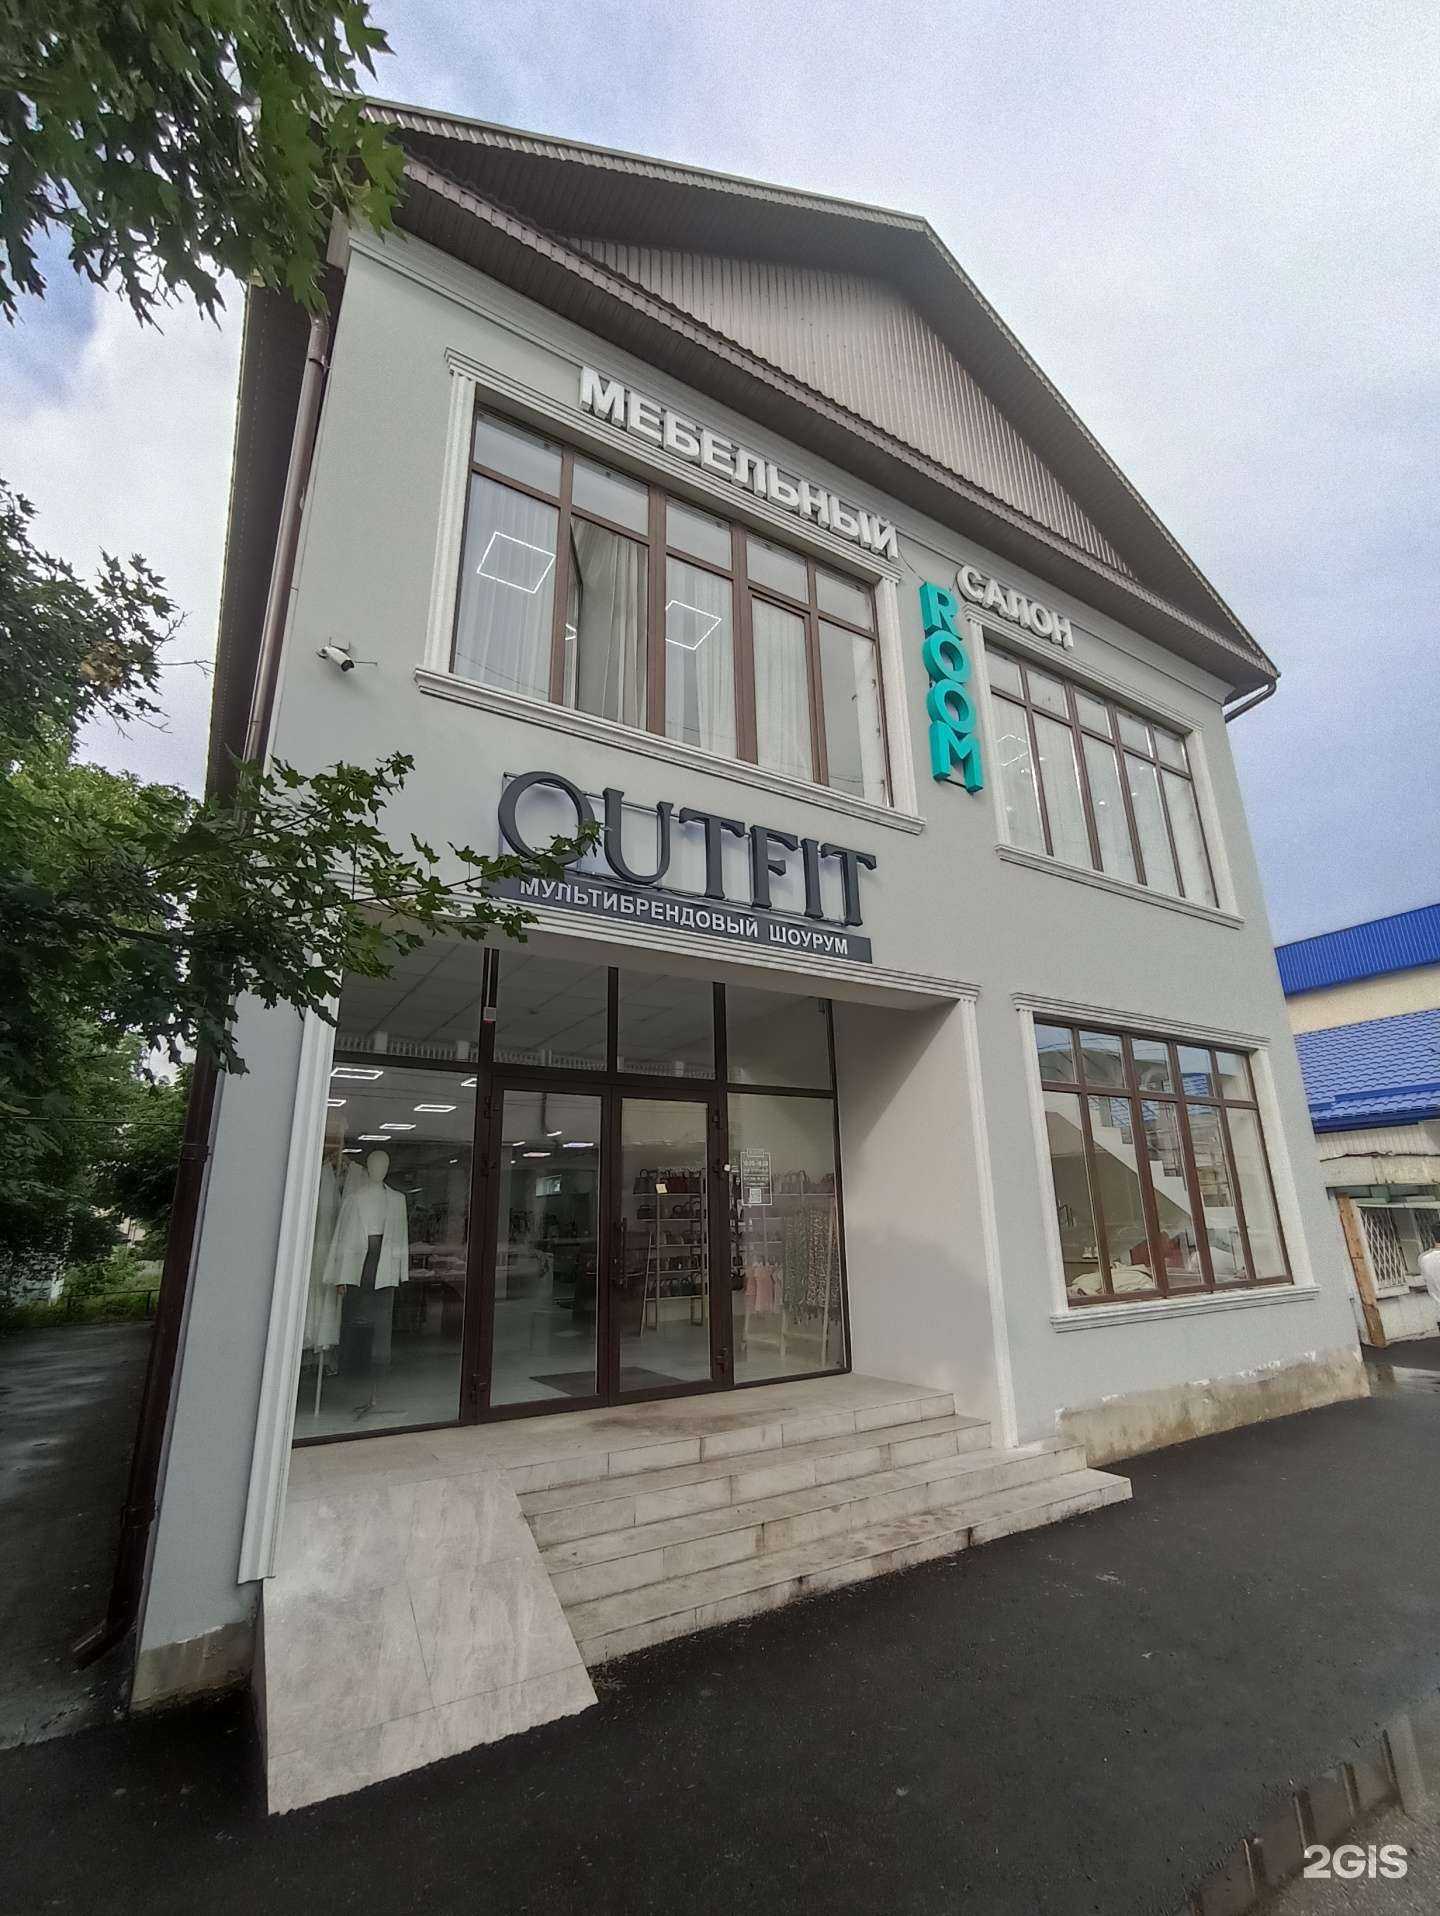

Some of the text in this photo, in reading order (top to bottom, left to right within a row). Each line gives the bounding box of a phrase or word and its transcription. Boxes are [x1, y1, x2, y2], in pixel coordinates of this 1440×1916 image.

[579, 366, 1074, 649] МЕБЕЛЬНЫЙ САЛОН
[919, 581, 984, 793] ROOM
[498, 771, 877, 926] OUTFIT
[520, 877, 848, 955] МУЛЬТИБРЕНДОВЫЙ ШОУРУМ
